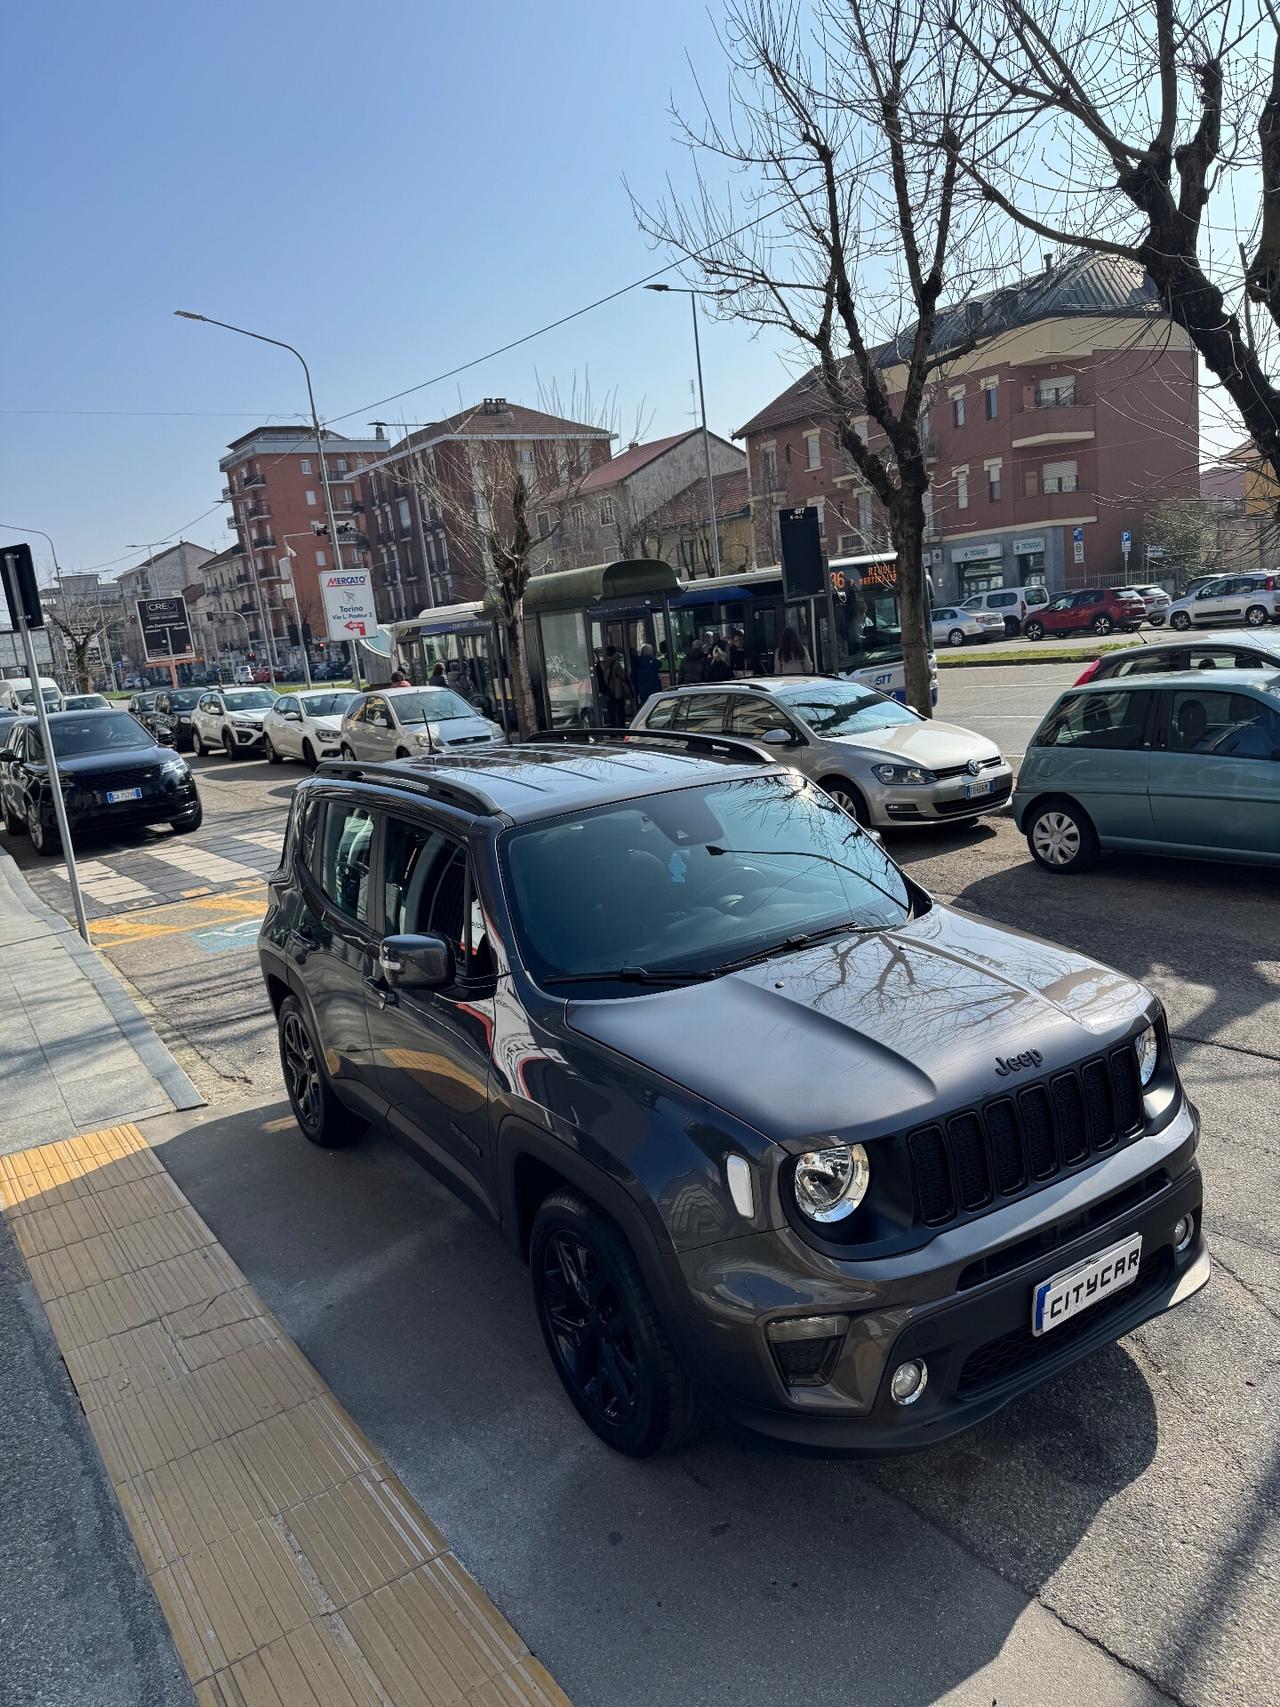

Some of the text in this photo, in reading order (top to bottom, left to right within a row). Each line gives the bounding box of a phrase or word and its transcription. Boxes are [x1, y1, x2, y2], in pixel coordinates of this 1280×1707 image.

[327, 576, 366, 587] MERCATO
[339, 605, 364, 613] Torino
[995, 1048, 1043, 1077] Jeep
[1050, 1248, 1140, 1319] CITYCAR
